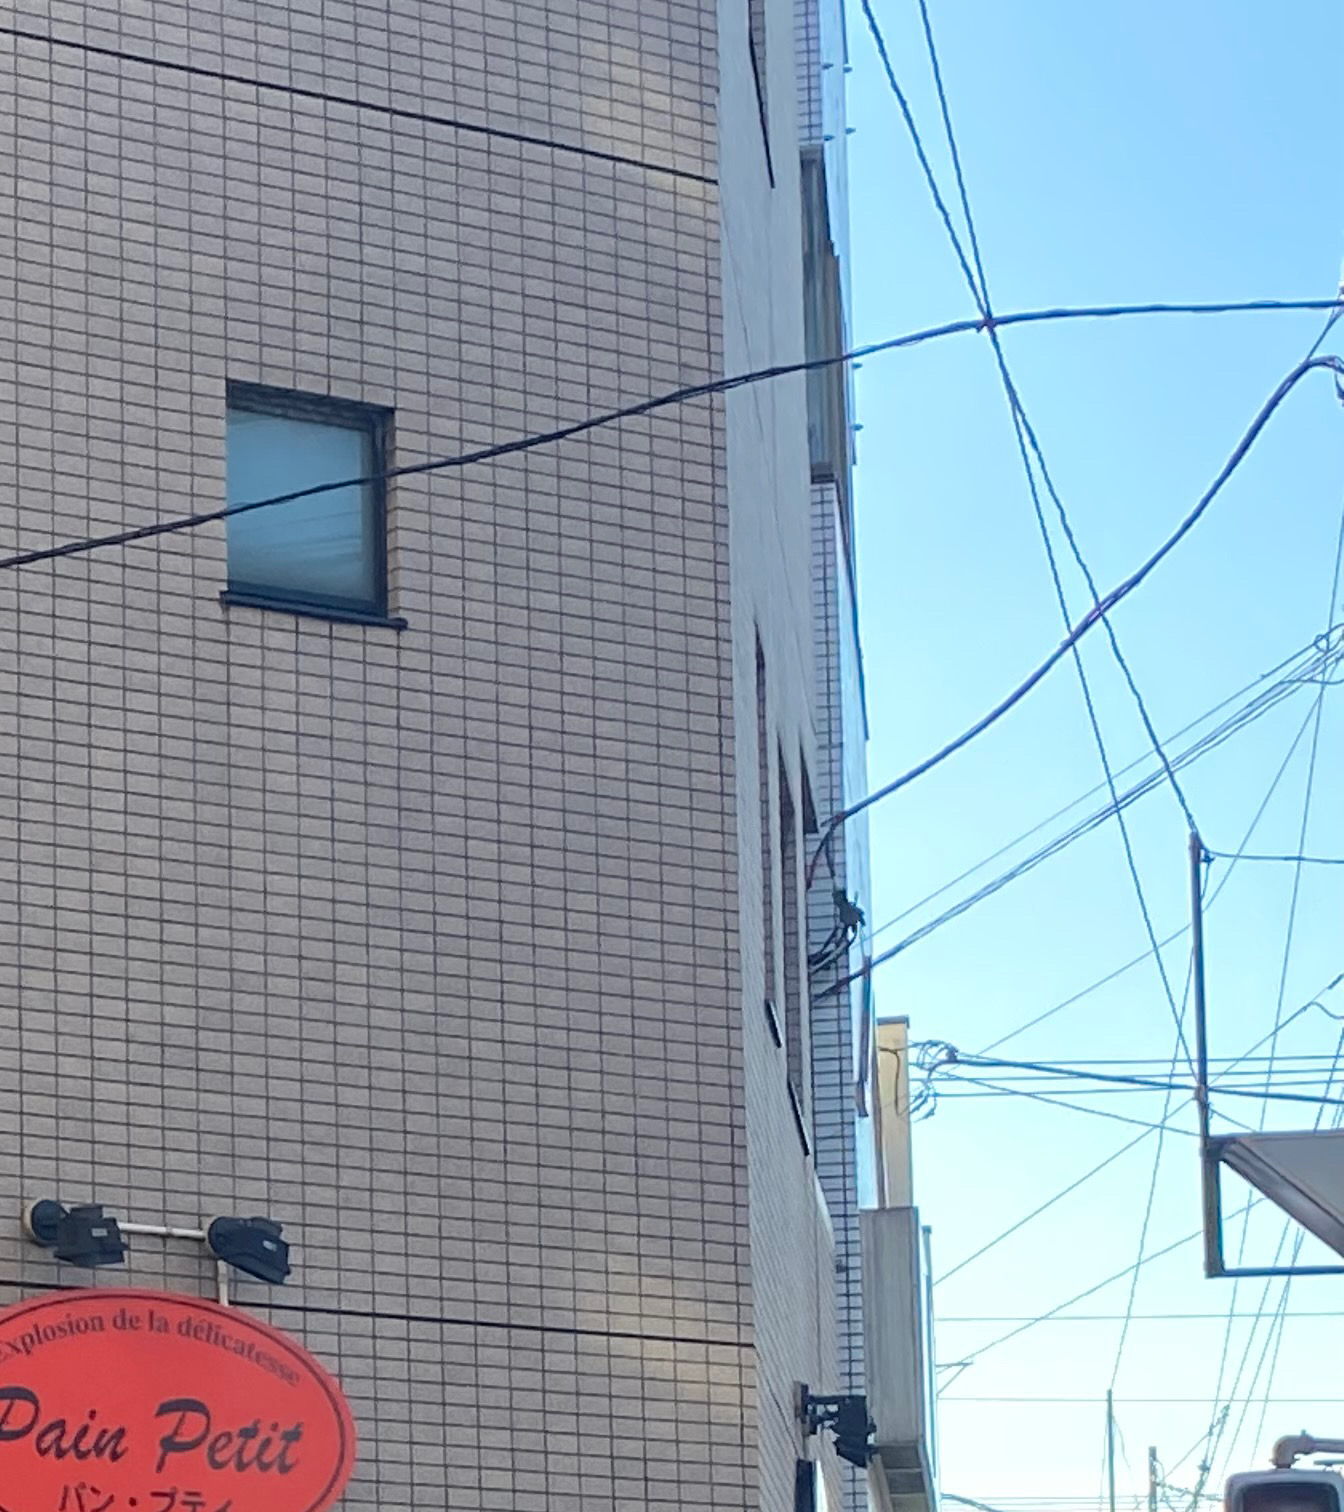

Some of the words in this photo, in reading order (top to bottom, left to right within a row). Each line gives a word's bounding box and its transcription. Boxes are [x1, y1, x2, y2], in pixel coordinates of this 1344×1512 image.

[112, 1308, 141, 1332] de
[148, 1310, 169, 1333] la
[177, 1317, 300, 1387] délicatesse
[154, 1398, 305, 1474] Petit
